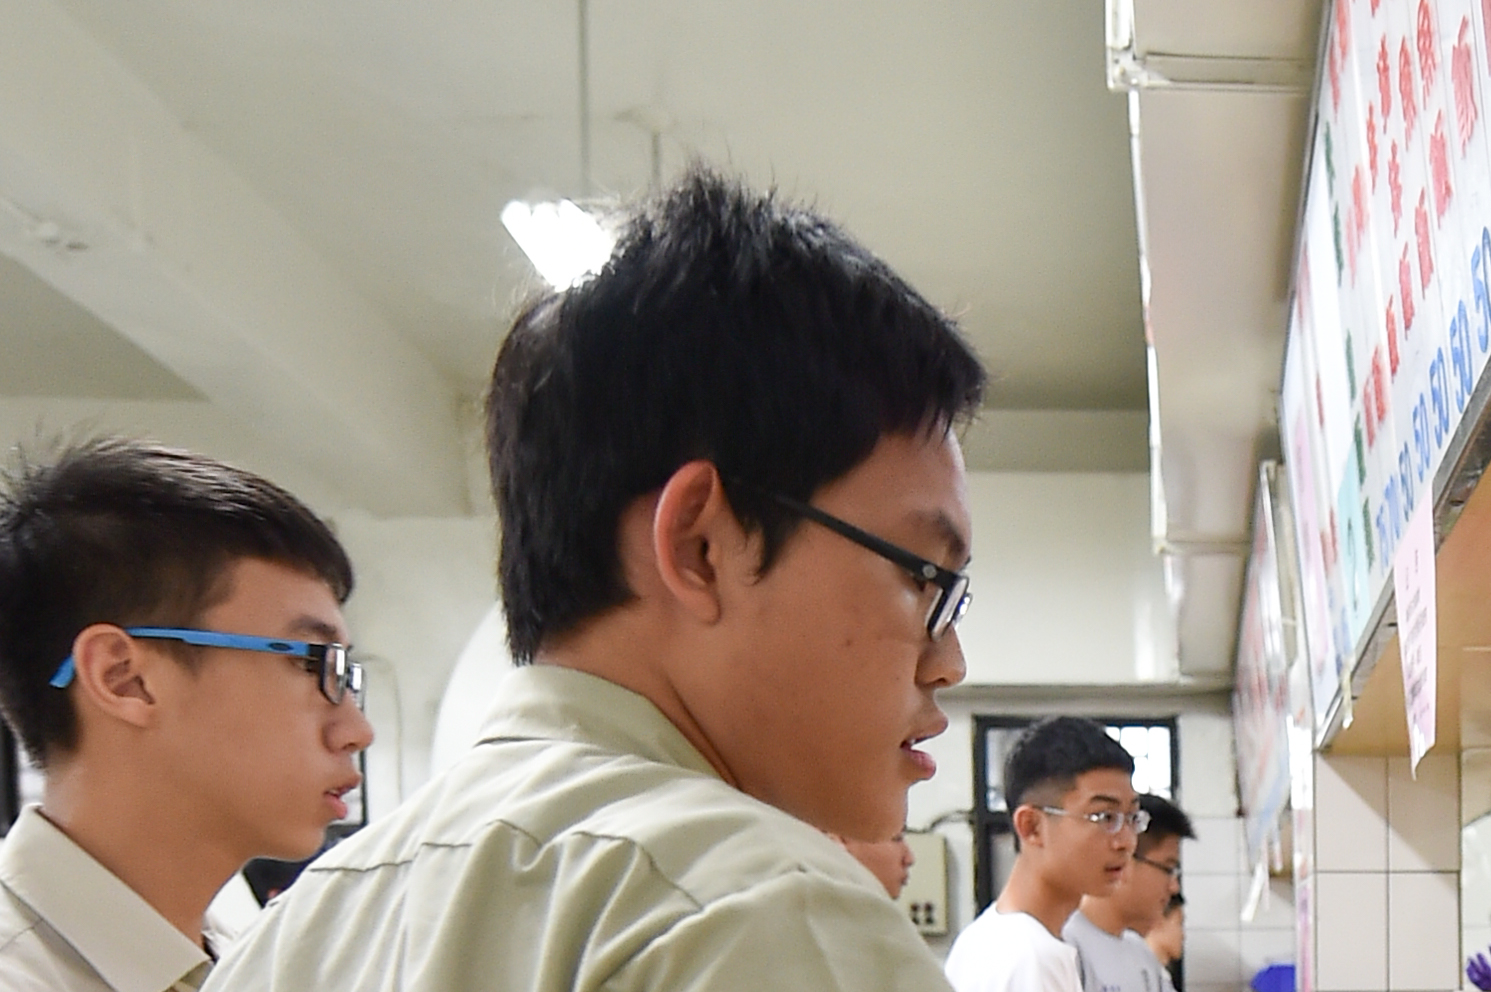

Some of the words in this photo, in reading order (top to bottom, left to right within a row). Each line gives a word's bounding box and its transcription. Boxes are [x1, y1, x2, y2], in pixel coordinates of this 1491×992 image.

[1429, 346, 1450, 449] 50
[1448, 299, 1474, 413] 50
[1398, 440, 1414, 523] 50
[1412, 392, 1431, 483] 50
